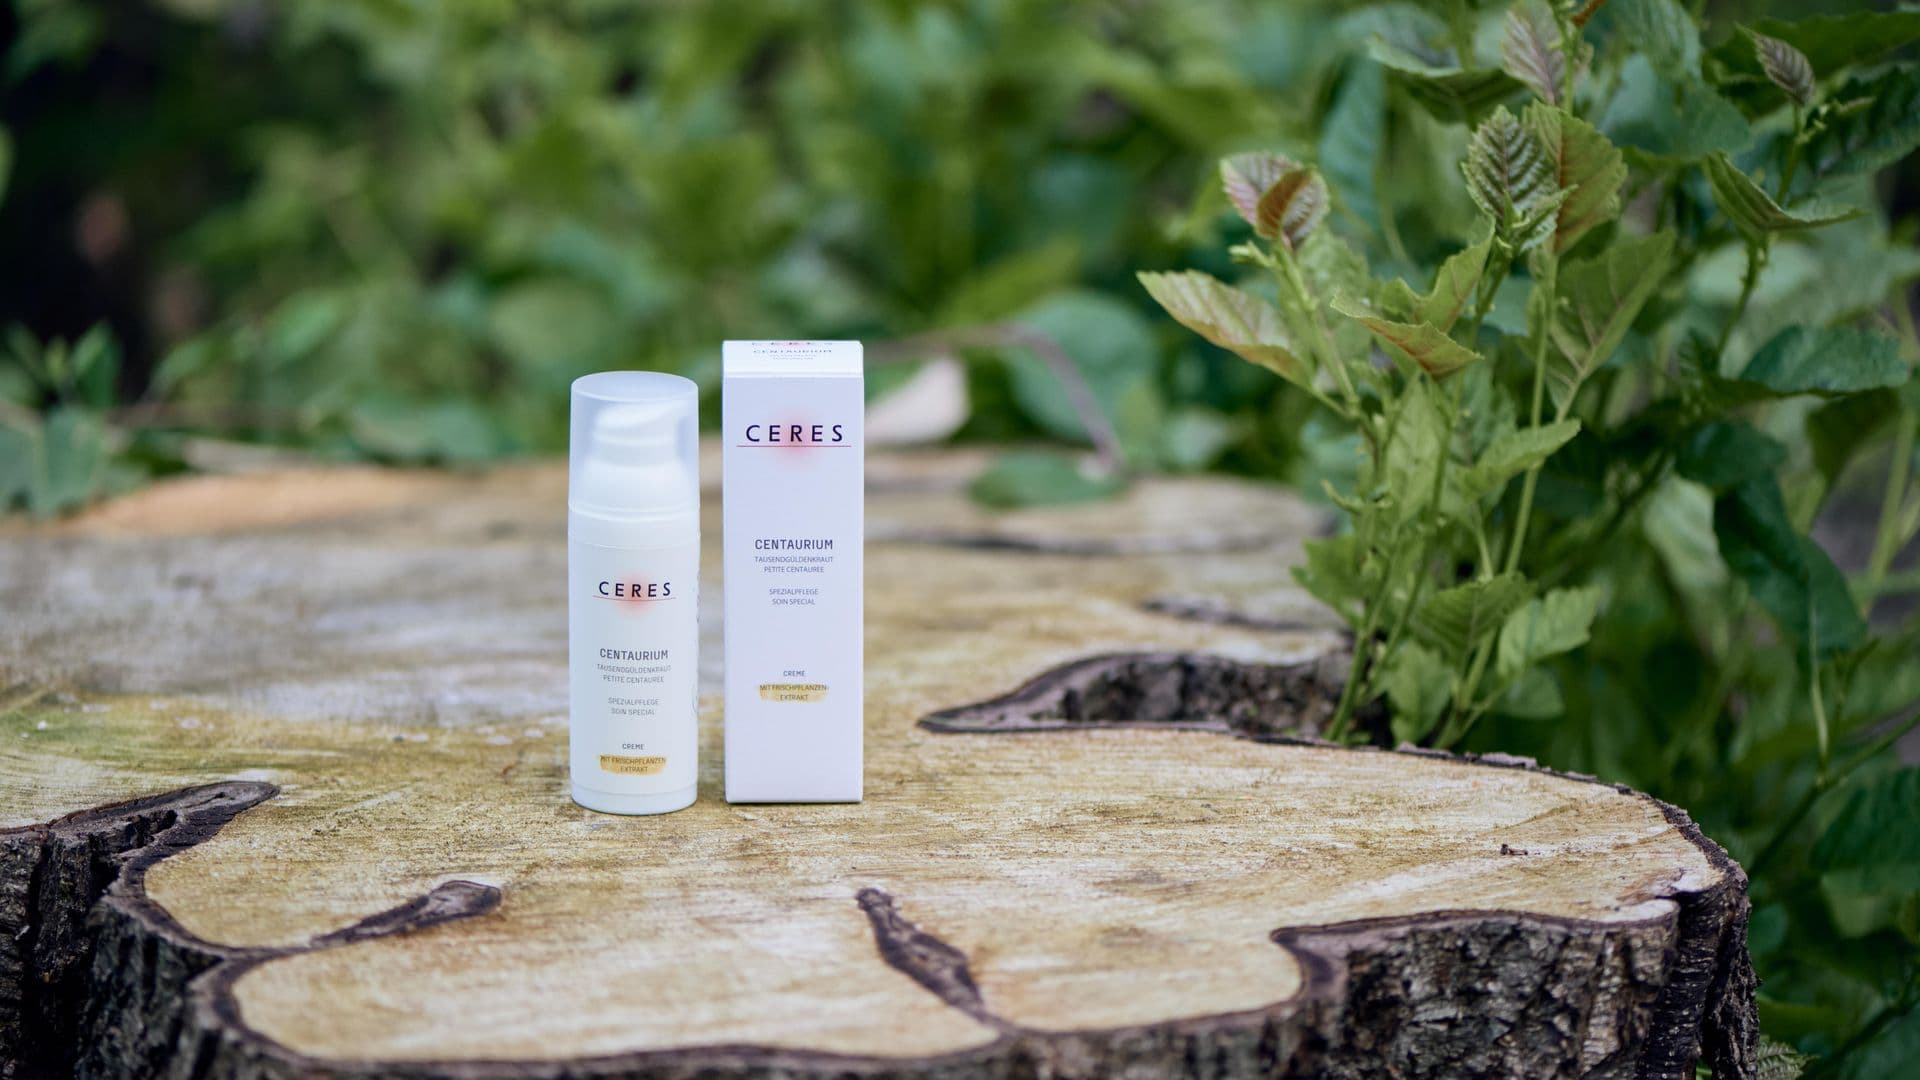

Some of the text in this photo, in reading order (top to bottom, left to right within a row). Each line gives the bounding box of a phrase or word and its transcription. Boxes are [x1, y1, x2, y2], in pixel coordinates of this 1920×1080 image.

[745, 424, 843, 442] CERES
[754, 539, 833, 550] CENTAURIUM
[754, 555, 833, 563] TAUSENDGÜLDENKRAUT
[598, 581, 671, 598] CERES
[769, 588, 818, 596] SPEZIALPFLEGE
[772, 598, 788, 606] SOIN
[599, 648, 669, 661] CENTAURIUM
[603, 674, 625, 684] PETITE
[608, 697, 659, 706] SPEZIALPFLEGE
